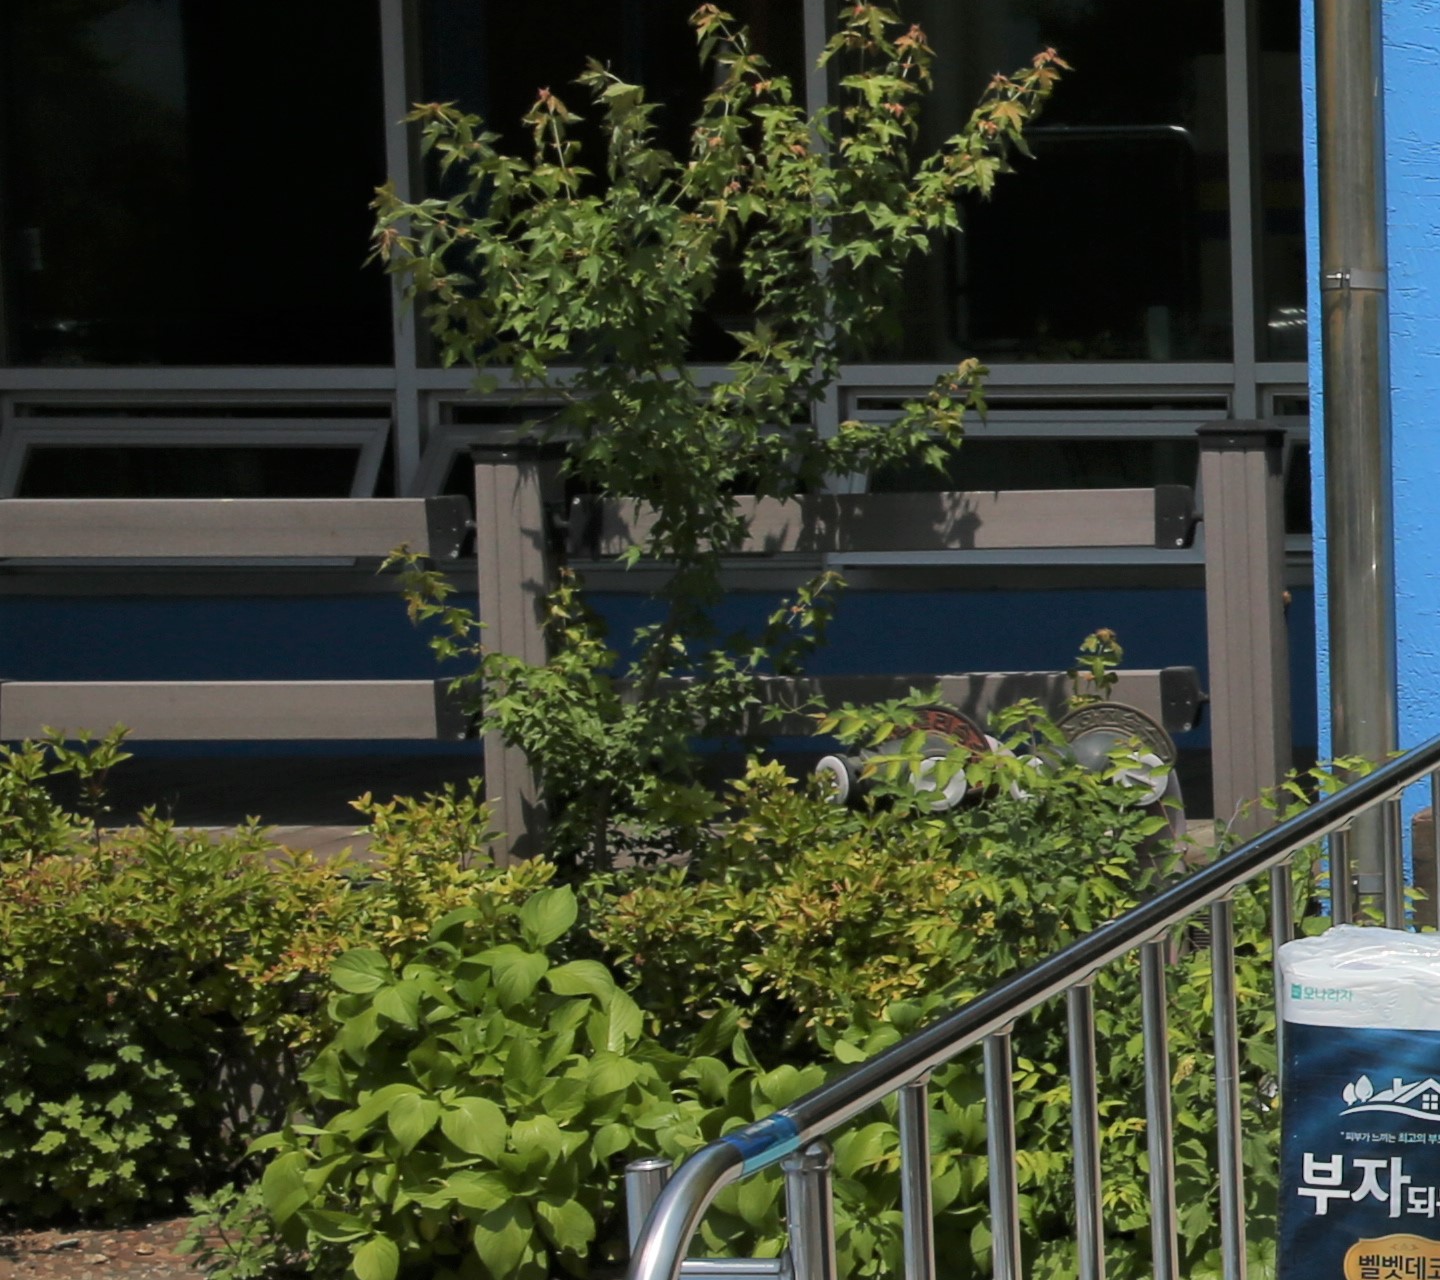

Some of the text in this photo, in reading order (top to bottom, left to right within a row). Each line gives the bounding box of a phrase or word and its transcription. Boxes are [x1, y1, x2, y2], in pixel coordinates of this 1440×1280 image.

[1304, 988, 1353, 1002] 모나리자
[1372, 1133, 1426, 1143] 느끼는 최고의
